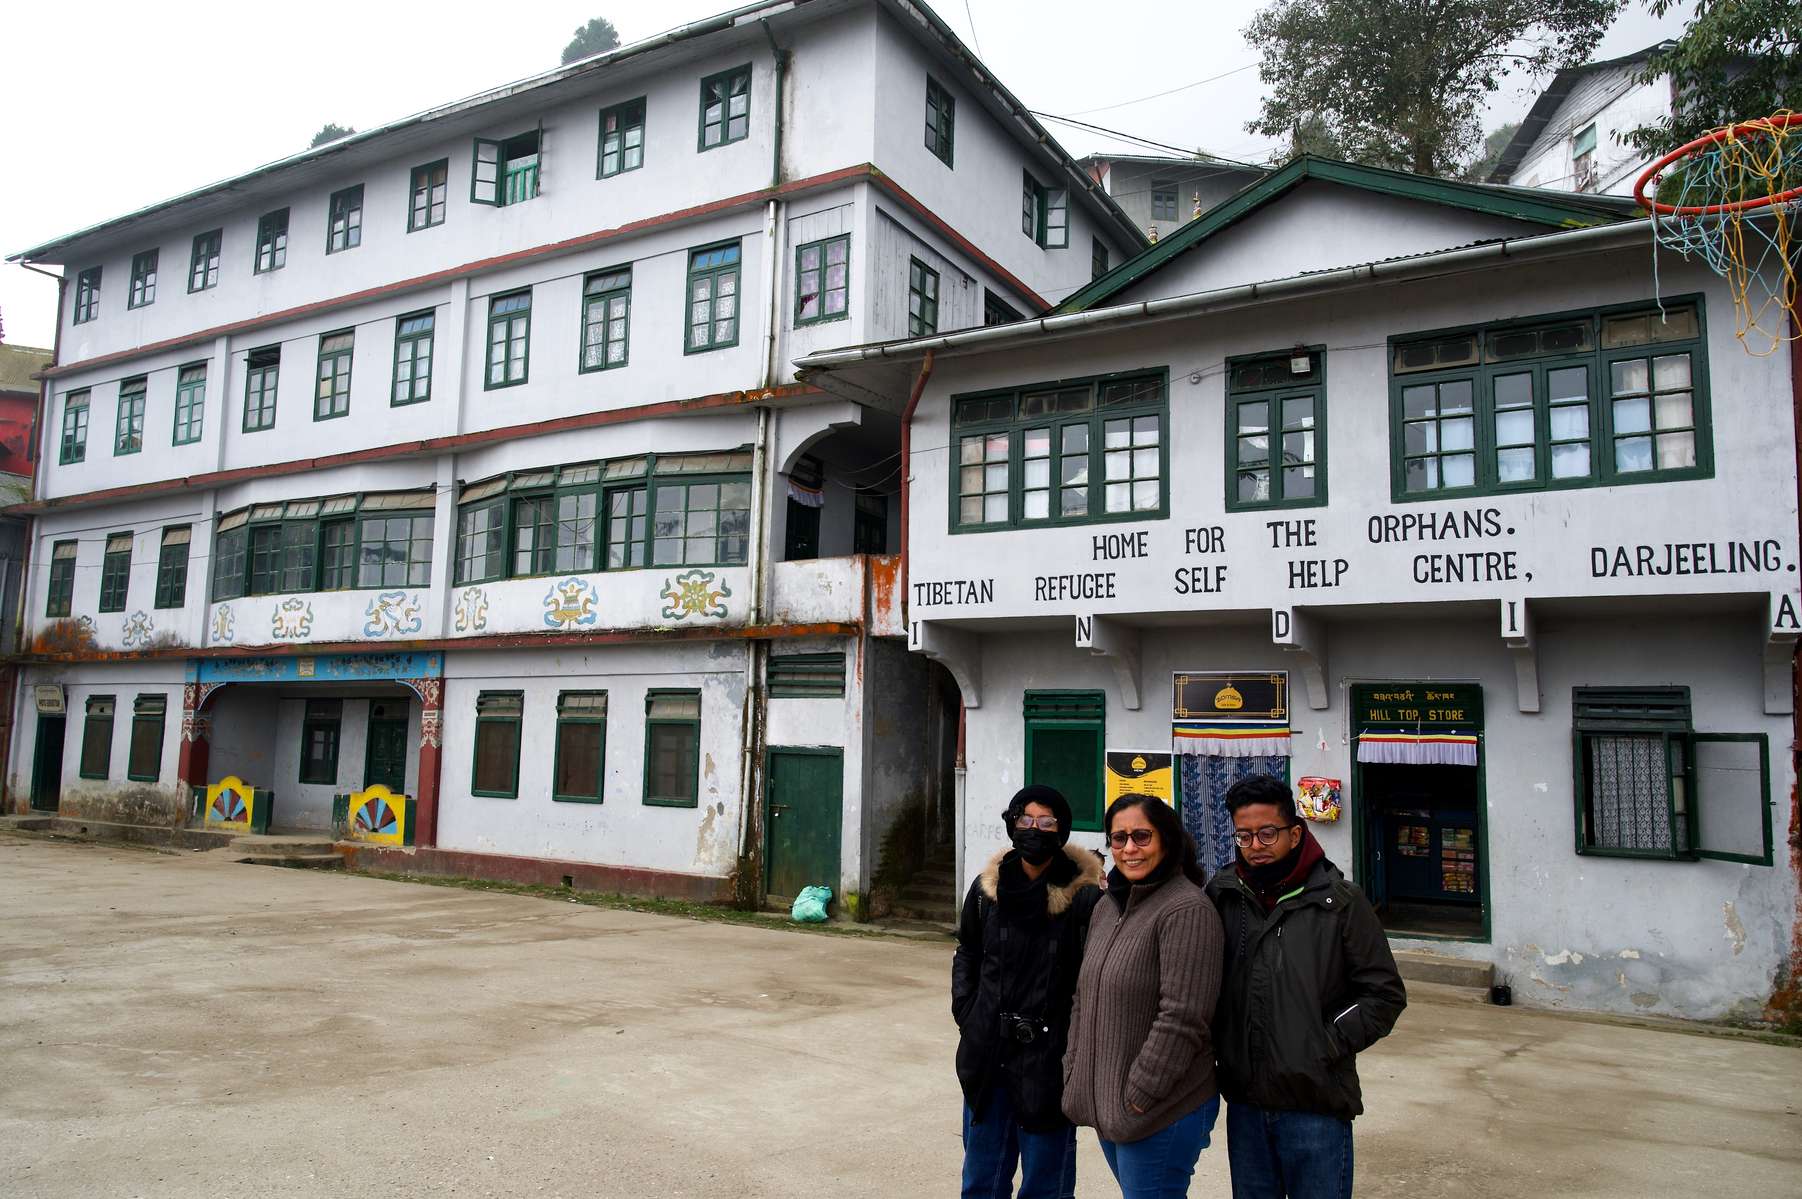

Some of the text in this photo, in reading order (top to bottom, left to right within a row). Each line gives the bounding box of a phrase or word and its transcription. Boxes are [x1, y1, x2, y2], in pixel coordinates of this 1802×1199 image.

[1092, 508, 1516, 561] HOME FOR THE ORPHANS.
[913, 539, 1796, 606] TIBETAN REFUGEE SELF HELP CENTRE, DARJEELING.
[912, 593, 1801, 645] I N D I A
[1369, 709, 1464, 721] HILL TOP STORE
